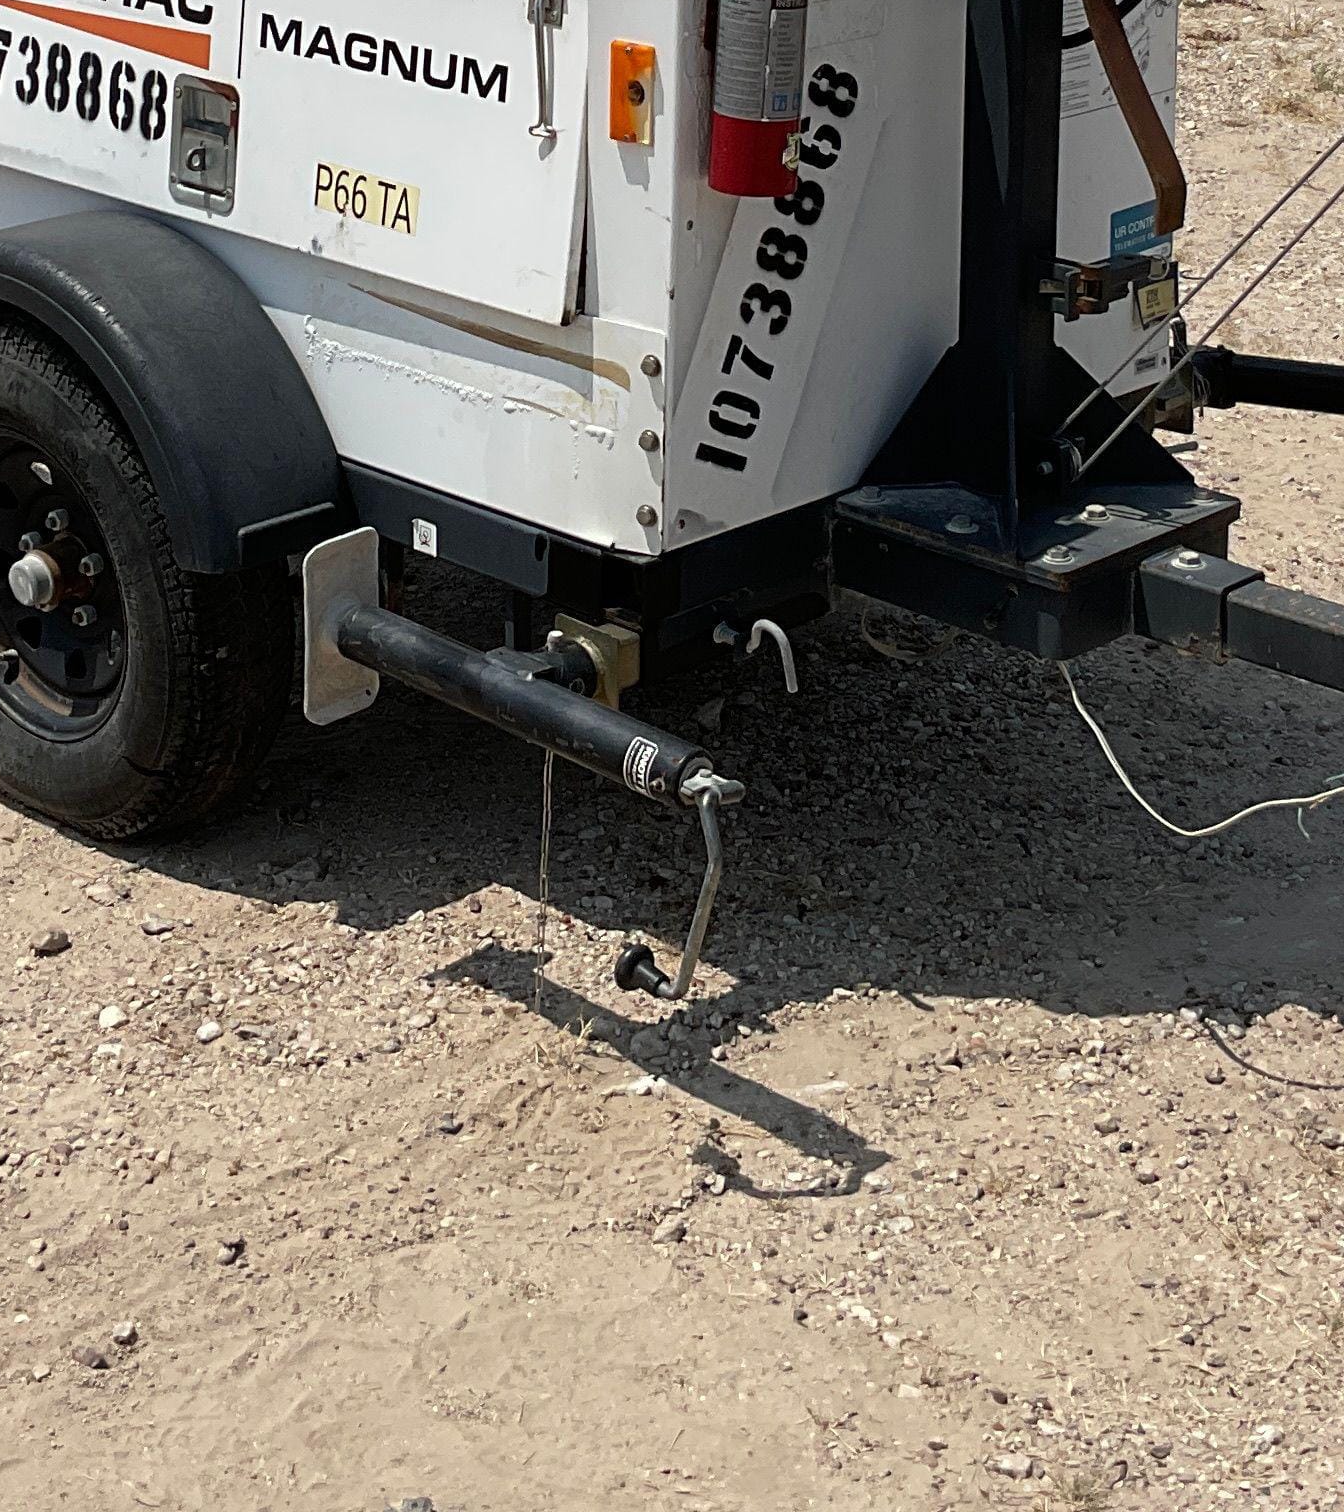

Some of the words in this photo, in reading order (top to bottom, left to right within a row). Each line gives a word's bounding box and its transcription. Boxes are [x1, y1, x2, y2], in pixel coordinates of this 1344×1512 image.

[258, 13, 510, 103] MAGNUM
[315, 163, 367, 219] P66
[377, 181, 413, 236] TA
[1115, 226, 1127, 239] UR
[695, 61, 860, 473] 10738868
